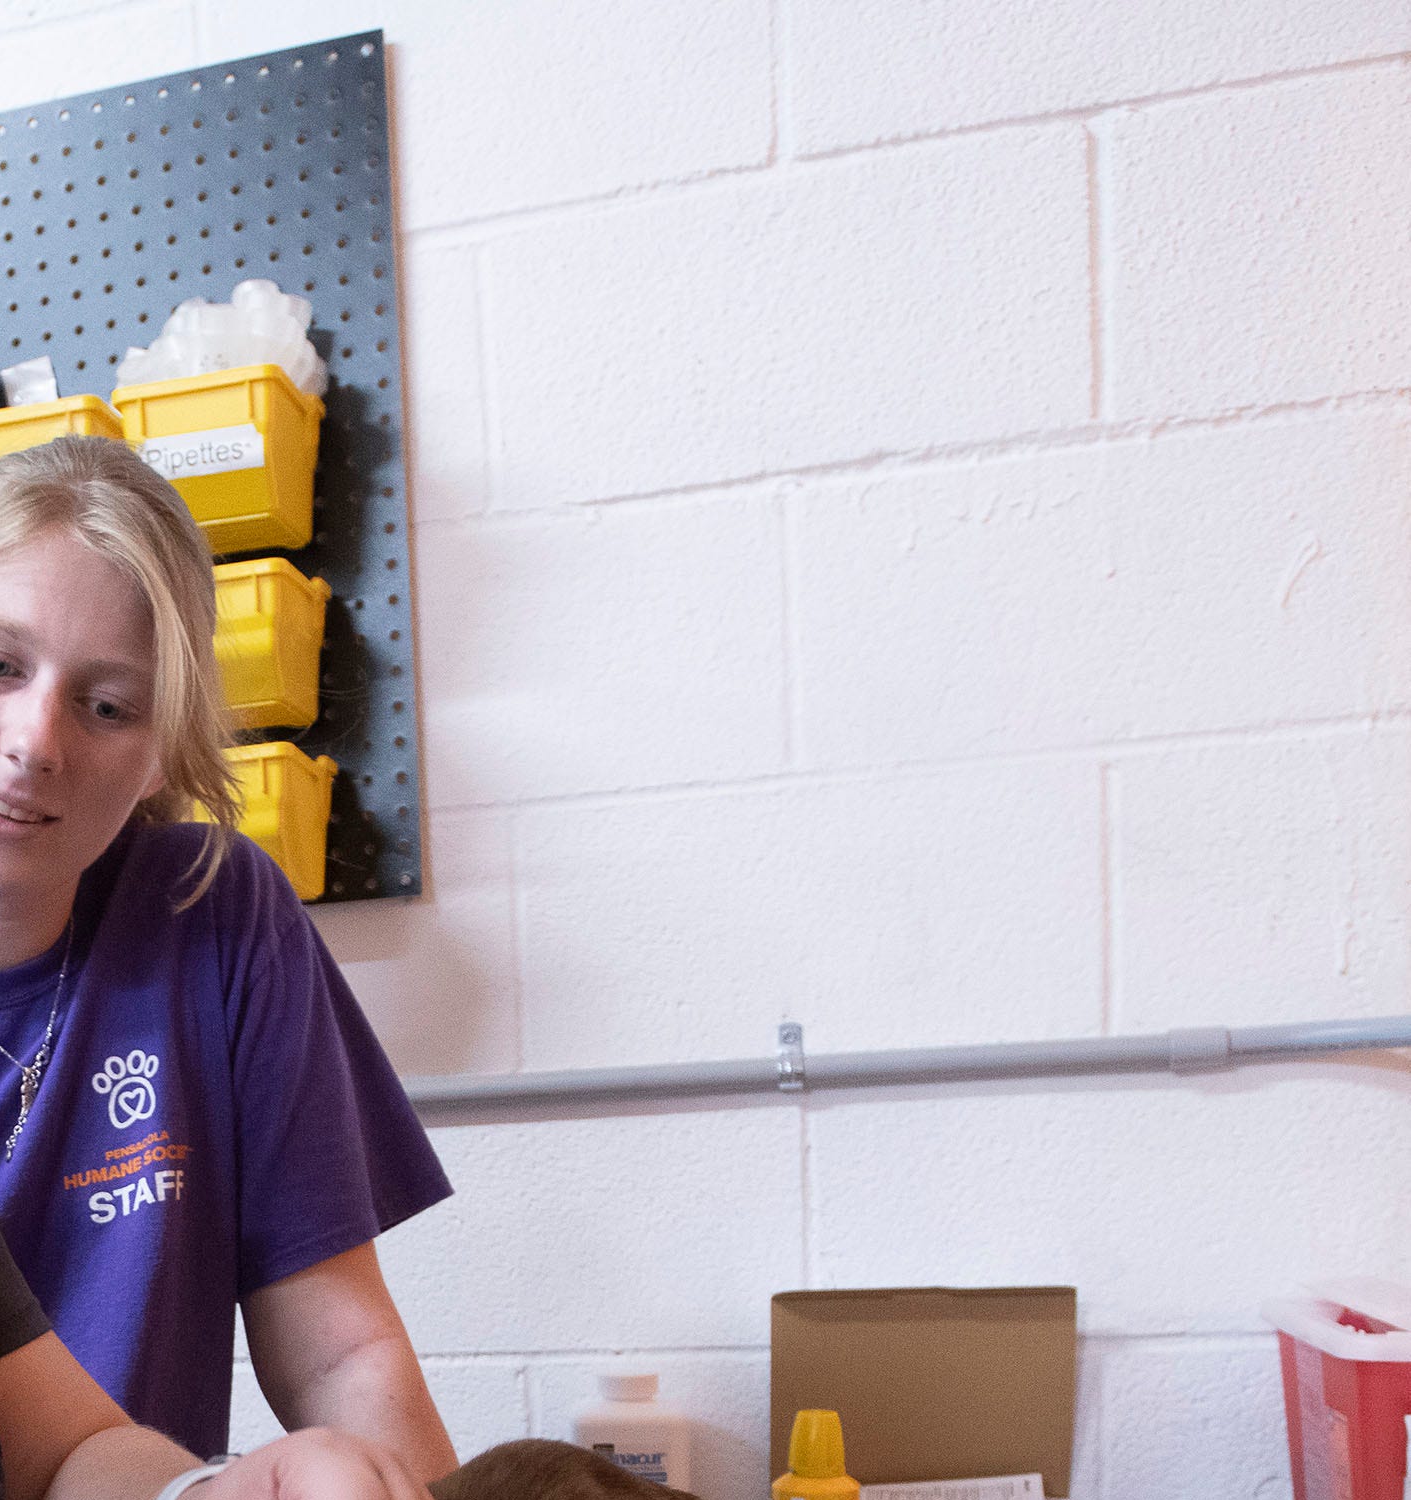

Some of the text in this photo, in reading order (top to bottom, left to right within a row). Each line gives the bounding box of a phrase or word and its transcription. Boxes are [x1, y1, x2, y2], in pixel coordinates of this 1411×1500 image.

[105, 1130, 169, 1161] PENSACOLA
[63, 1156, 142, 1190] HUMANE
[88, 1170, 185, 1224] STAFF
